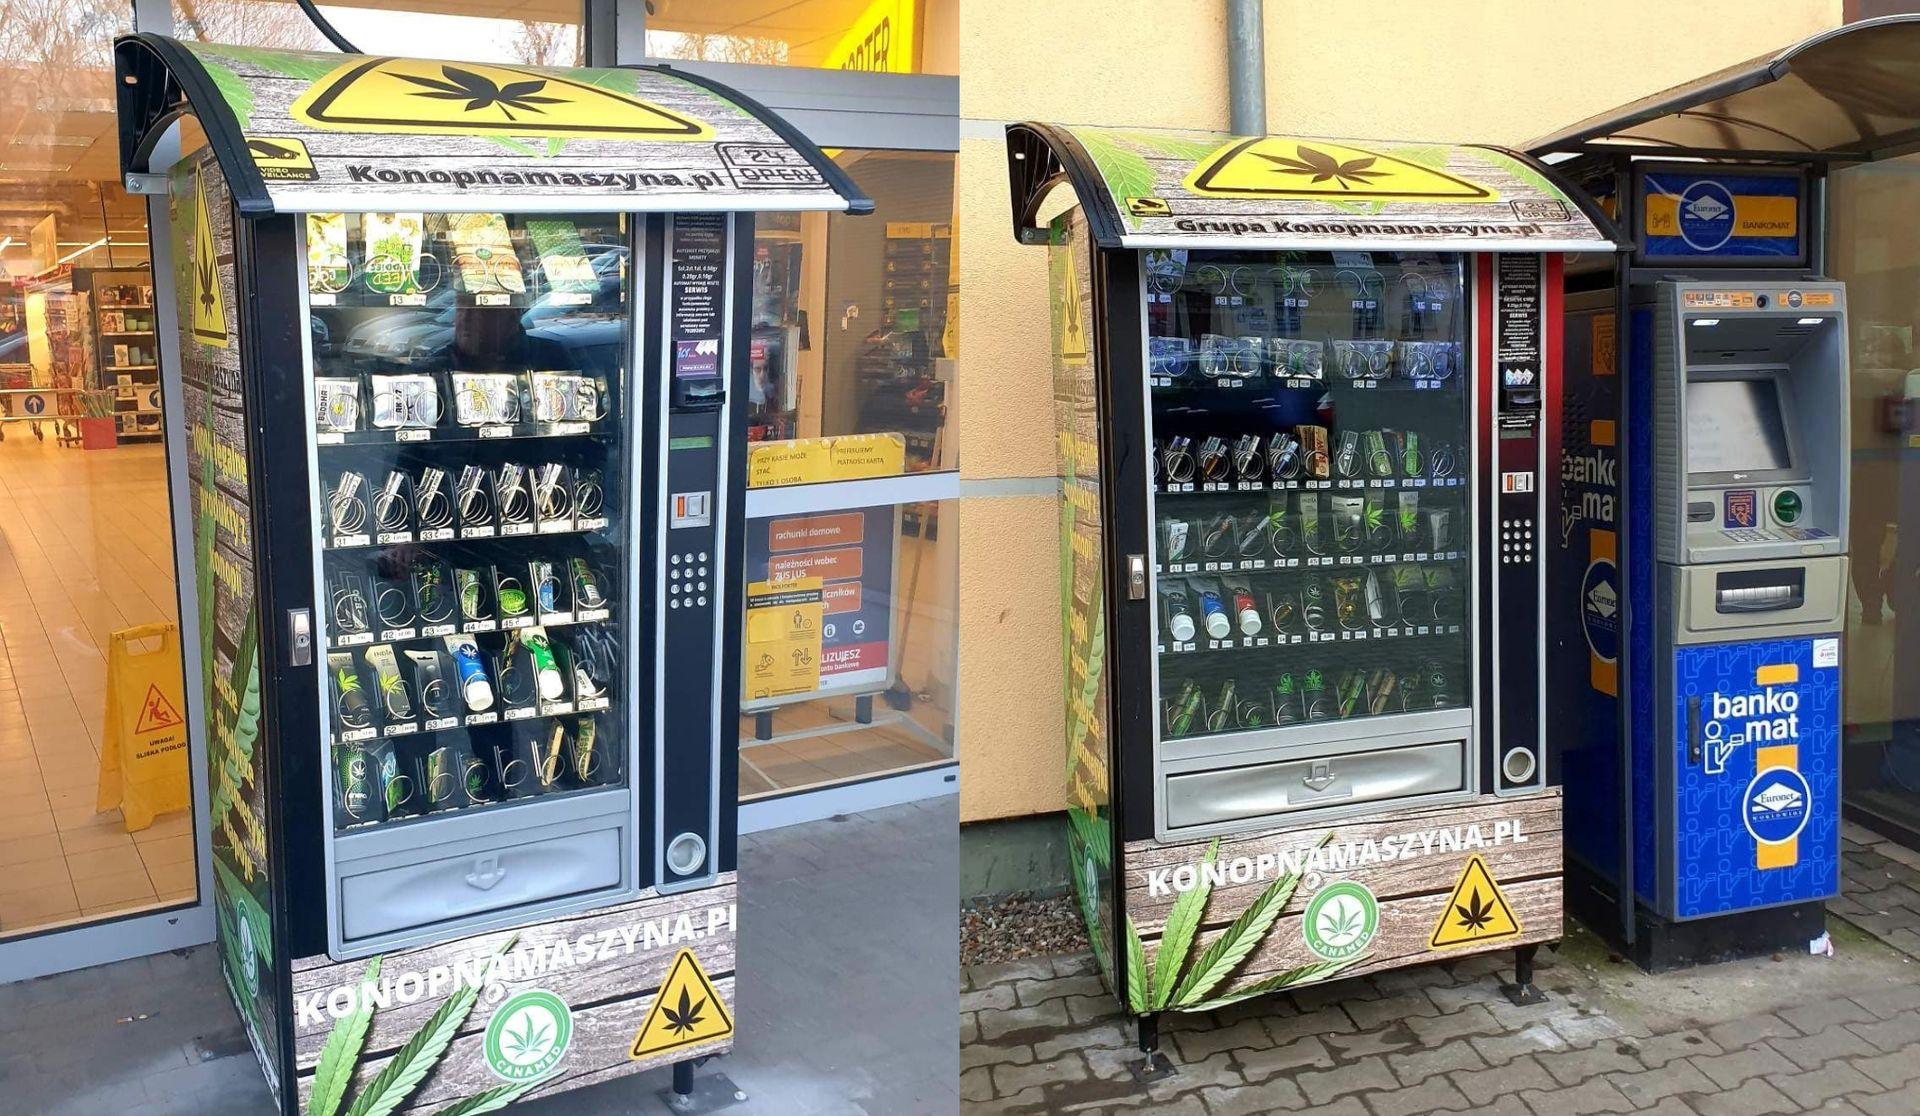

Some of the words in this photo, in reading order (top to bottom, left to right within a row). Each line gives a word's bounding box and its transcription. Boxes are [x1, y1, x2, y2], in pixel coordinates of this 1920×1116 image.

[744, 149, 786, 163] 24
[346, 164, 725, 190] Konopnamaszyna.pl
[739, 168, 816, 182] OPEN
[1174, 219, 1268, 236] Grupa
[1274, 219, 1545, 237] Konopnamaszyna.pl
[1742, 222, 1790, 230] BANKOMAT
[684, 286, 708, 294] SERWIS
[392, 296, 403, 304] 13
[479, 296, 488, 304] 15
[318, 390, 328, 421] BUDDHA
[398, 431, 408, 440] 23
[480, 428, 491, 437] 25
[213, 431, 248, 484] legalne
[790, 452, 806, 460] MOŻE
[1582, 492, 1616, 522] ma
[199, 485, 238, 546] produkty
[462, 528, 474, 536] 34
[502, 526, 513, 534] 35
[776, 528, 808, 540] rachunki
[809, 525, 840, 536] domowe
[378, 534, 390, 542] 32
[422, 532, 433, 540] 33
[336, 537, 346, 546] 31
[775, 557, 813, 571] należności
[814, 555, 837, 566] wobec
[208, 546, 242, 600] konopii
[774, 570, 790, 580] ZUS
[796, 569, 806, 578] US
[1592, 589, 1616, 607] Eurone
[424, 627, 435, 635] 43
[465, 623, 476, 631] 44
[340, 636, 350, 644] 41
[383, 632, 394, 640] 42
[821, 649, 861, 664] LIZUJESZ
[820, 664, 834, 672] onto
[1713, 686, 1799, 720] banko
[506, 710, 516, 718] 55
[467, 716, 477, 724] 54
[386, 726, 397, 735] 52
[426, 722, 438, 730] 53
[1746, 712, 1799, 742] mat
[150, 736, 176, 746] UWAGA!
[344, 732, 354, 741] 51
[1760, 793, 1794, 804] Euronet
[1148, 820, 1529, 898] KONOPNAMASZYNA.PL
[1312, 931, 1370, 958] CANAMED
[496, 1045, 563, 1078] CANAMED
